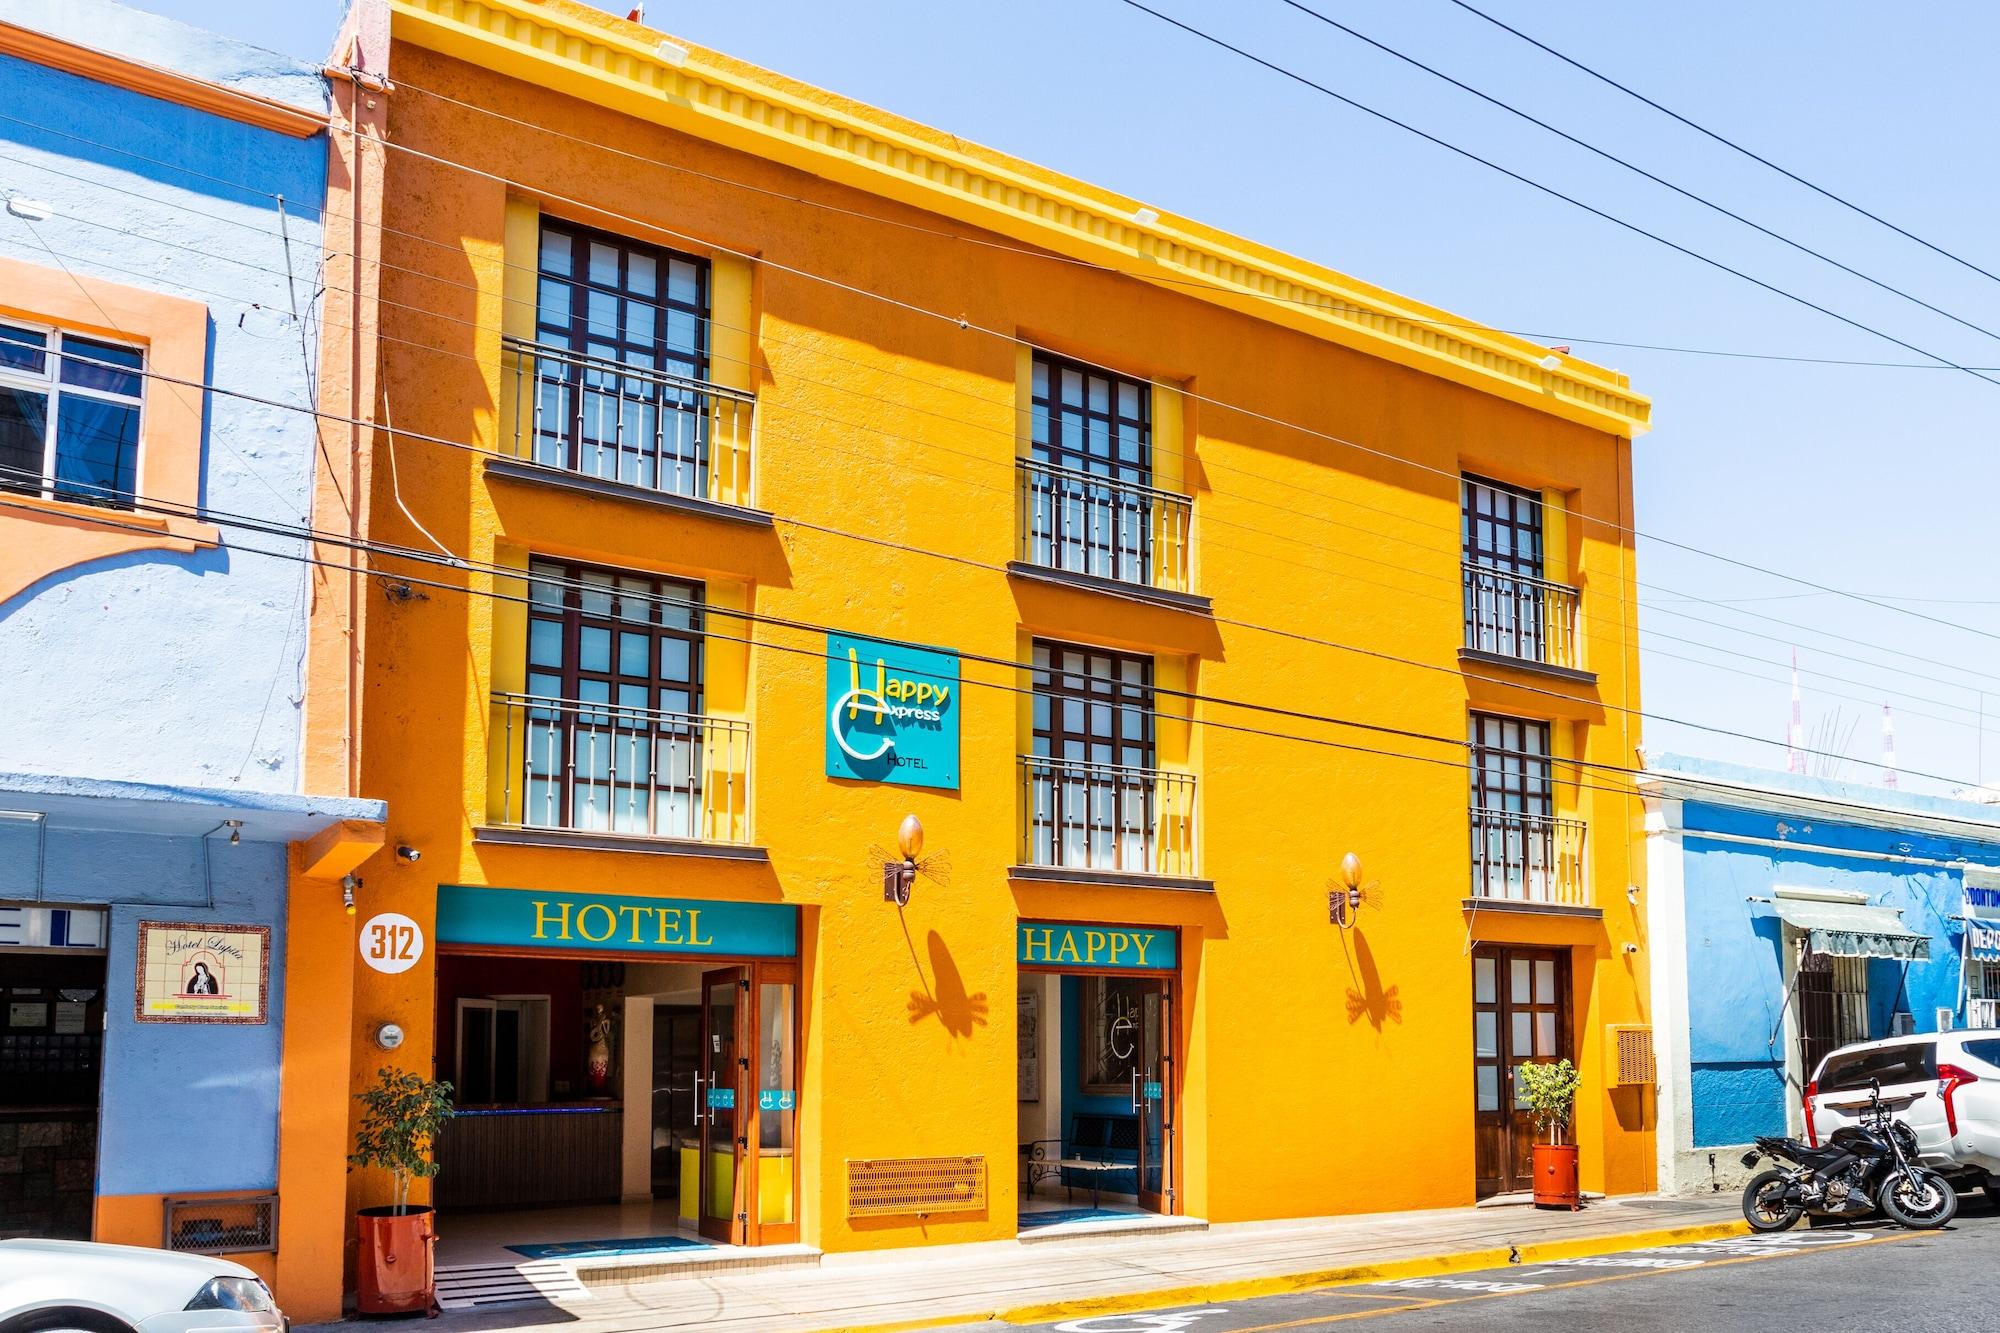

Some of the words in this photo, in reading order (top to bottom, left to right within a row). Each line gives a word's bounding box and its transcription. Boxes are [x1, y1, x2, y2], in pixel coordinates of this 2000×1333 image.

[848, 647, 949, 725] Happy
[887, 753, 928, 770] HOTEL
[531, 900, 713, 946] HOTEL
[167, 935, 203, 956] Hotel
[207, 936, 244, 960] Lupita
[370, 924, 414, 960] 312
[1022, 927, 1155, 966] HAPPY
